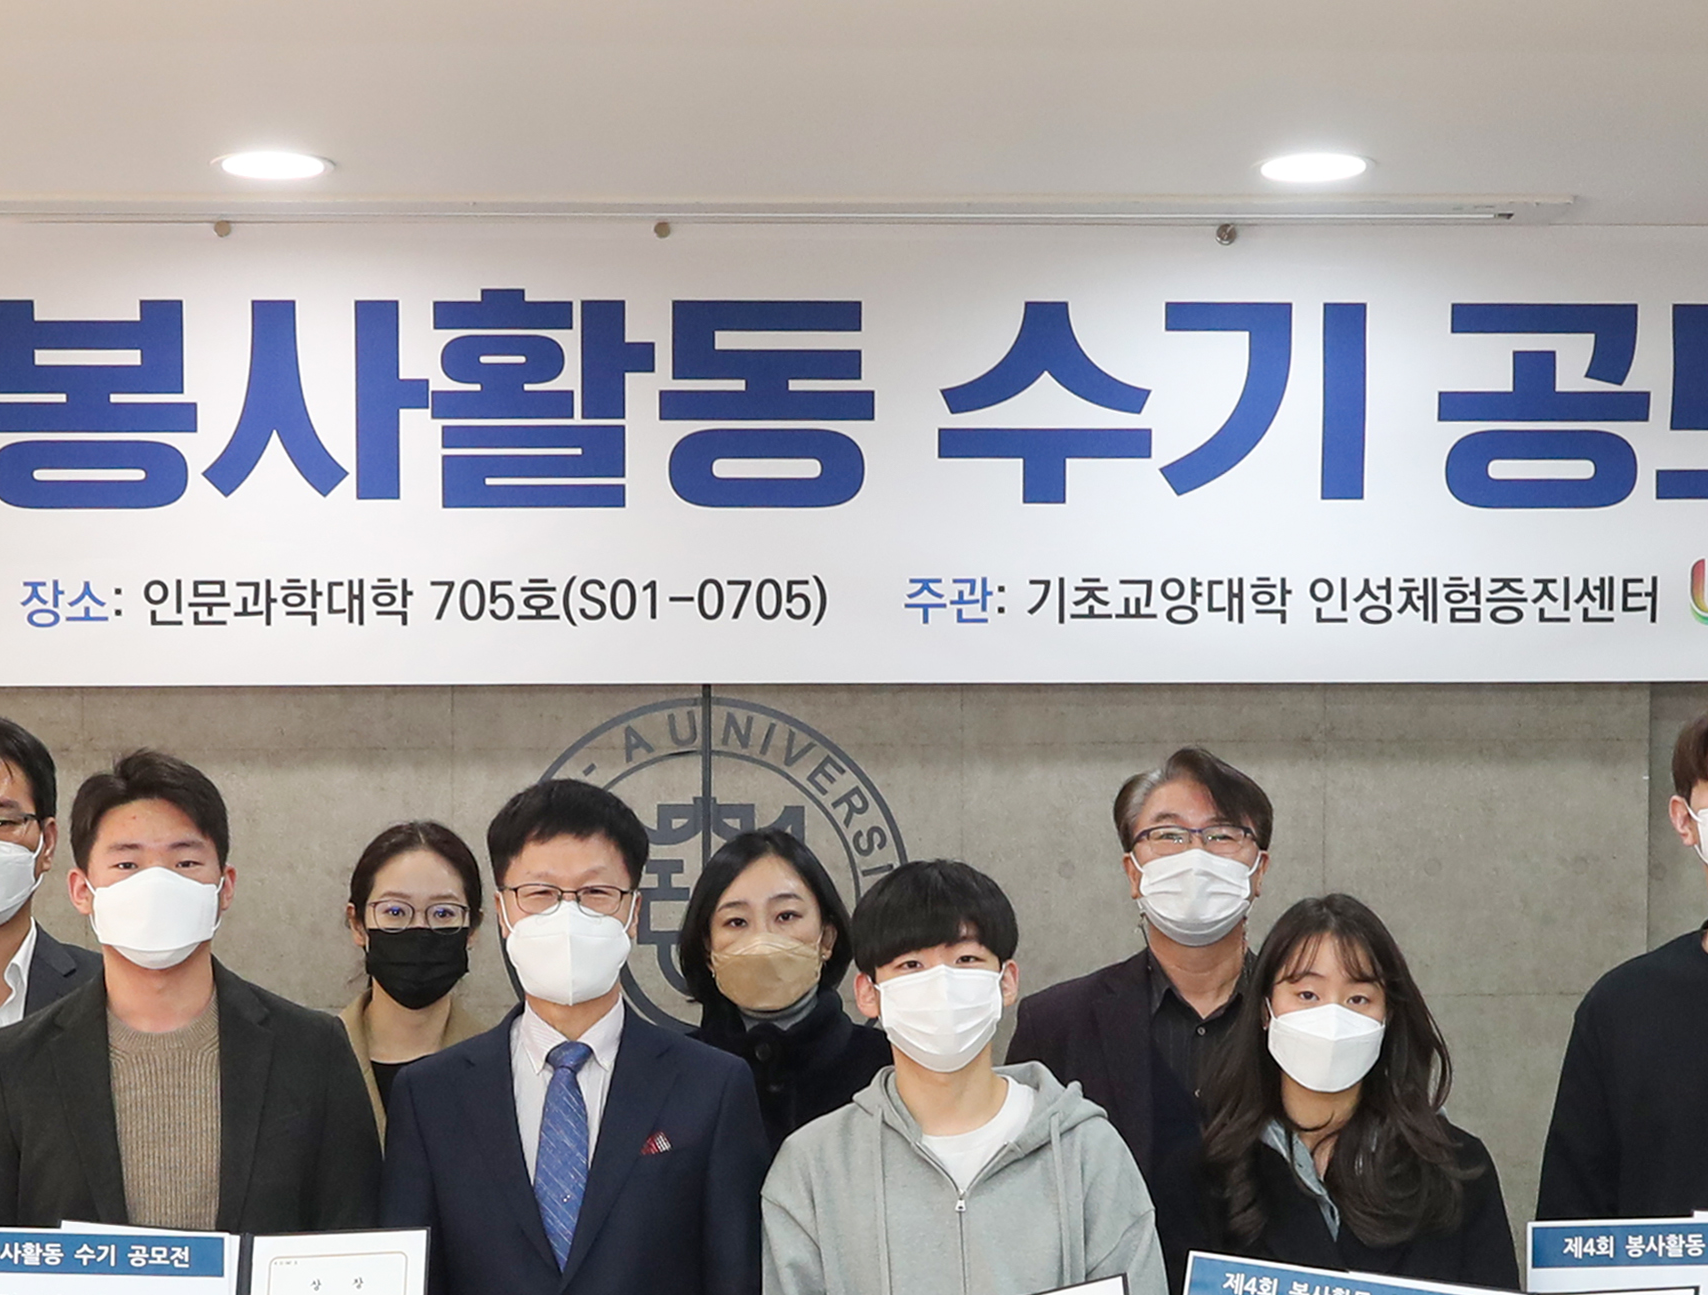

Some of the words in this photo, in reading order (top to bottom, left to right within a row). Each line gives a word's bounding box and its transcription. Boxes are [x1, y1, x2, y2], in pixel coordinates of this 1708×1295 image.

[937, 300, 1368, 505] 수기
[20, 579, 123, 628] 장소:
[143, 578, 414, 627] 인문과학대학
[430, 574, 827, 627] 705호(S01-0705)
[904, 576, 1006, 625] 주관:
[1027, 576, 1293, 625] 기초교양대학
[1309, 575, 1658, 625] 인성체험증진센터
[74, 1243, 116, 1267] 수기
[127, 1245, 190, 1268] 공모전
[1563, 1235, 1614, 1259] 제4회
[1625, 1233, 1706, 1258] 봉사활동
